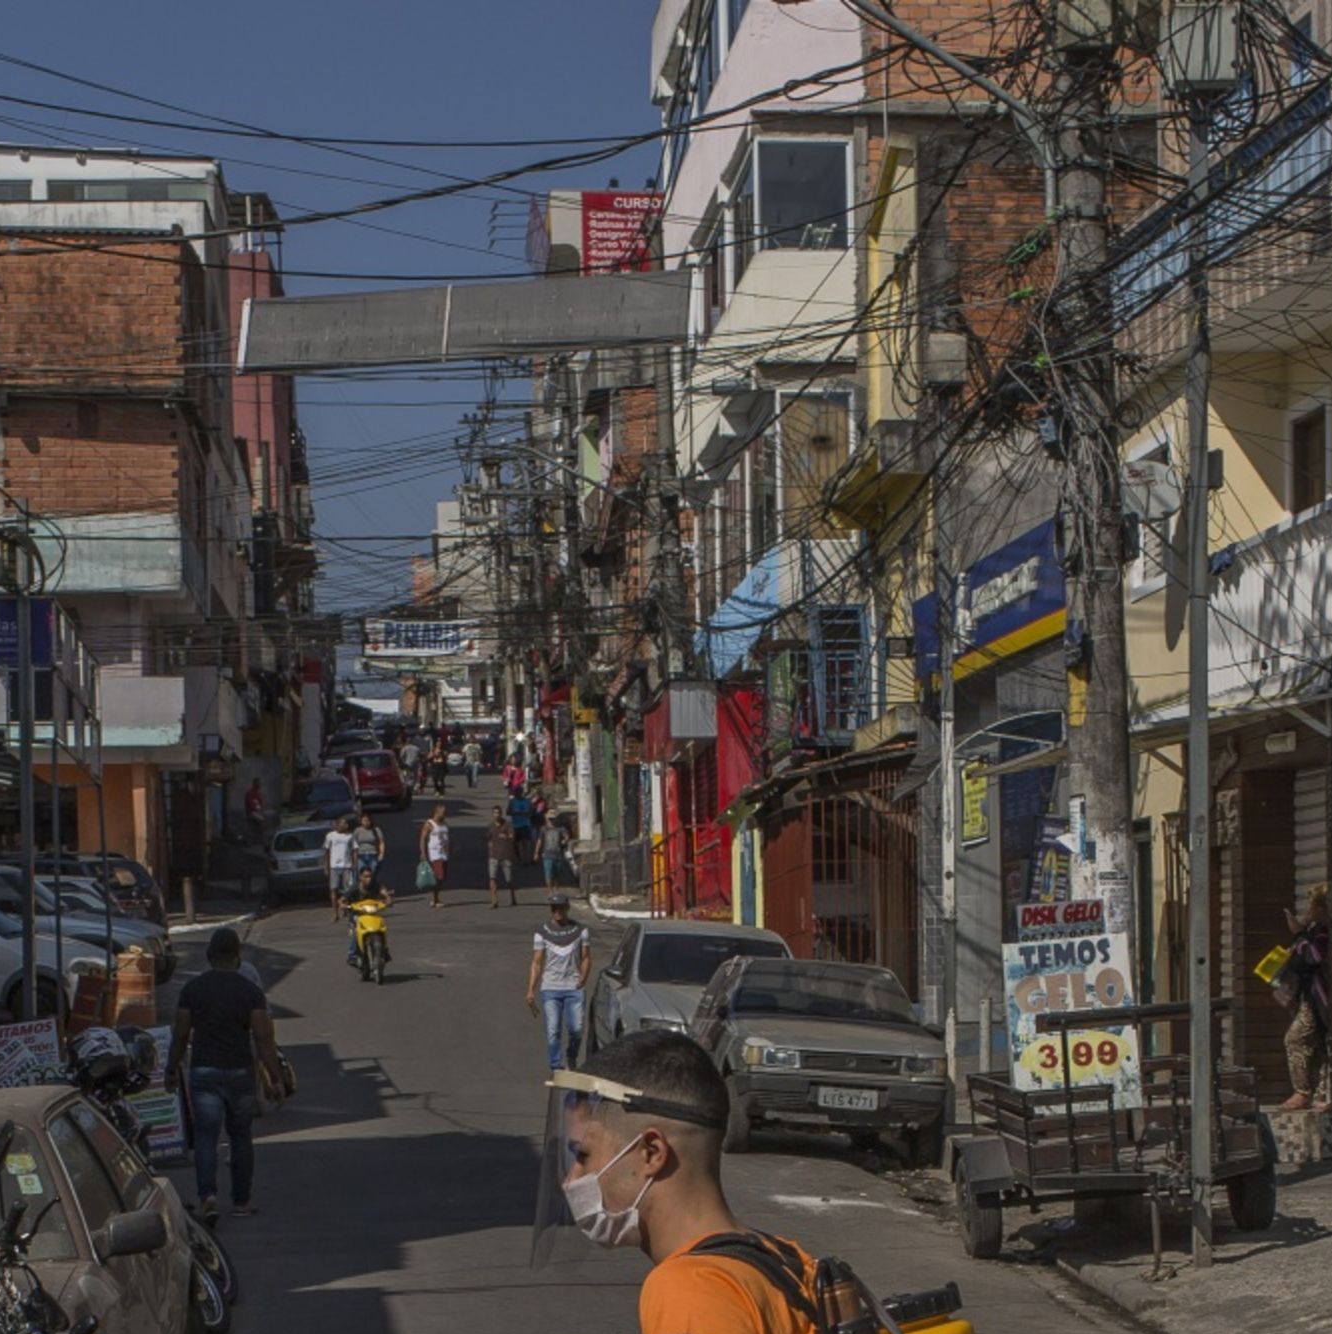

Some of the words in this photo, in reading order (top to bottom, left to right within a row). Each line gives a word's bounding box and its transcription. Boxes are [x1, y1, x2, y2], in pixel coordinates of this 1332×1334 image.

[1021, 905, 1058, 928] DISK
[1063, 900, 1102, 923] GELO
[1018, 937, 1111, 969] TEMOS
[1013, 967, 1126, 1014] GELO
